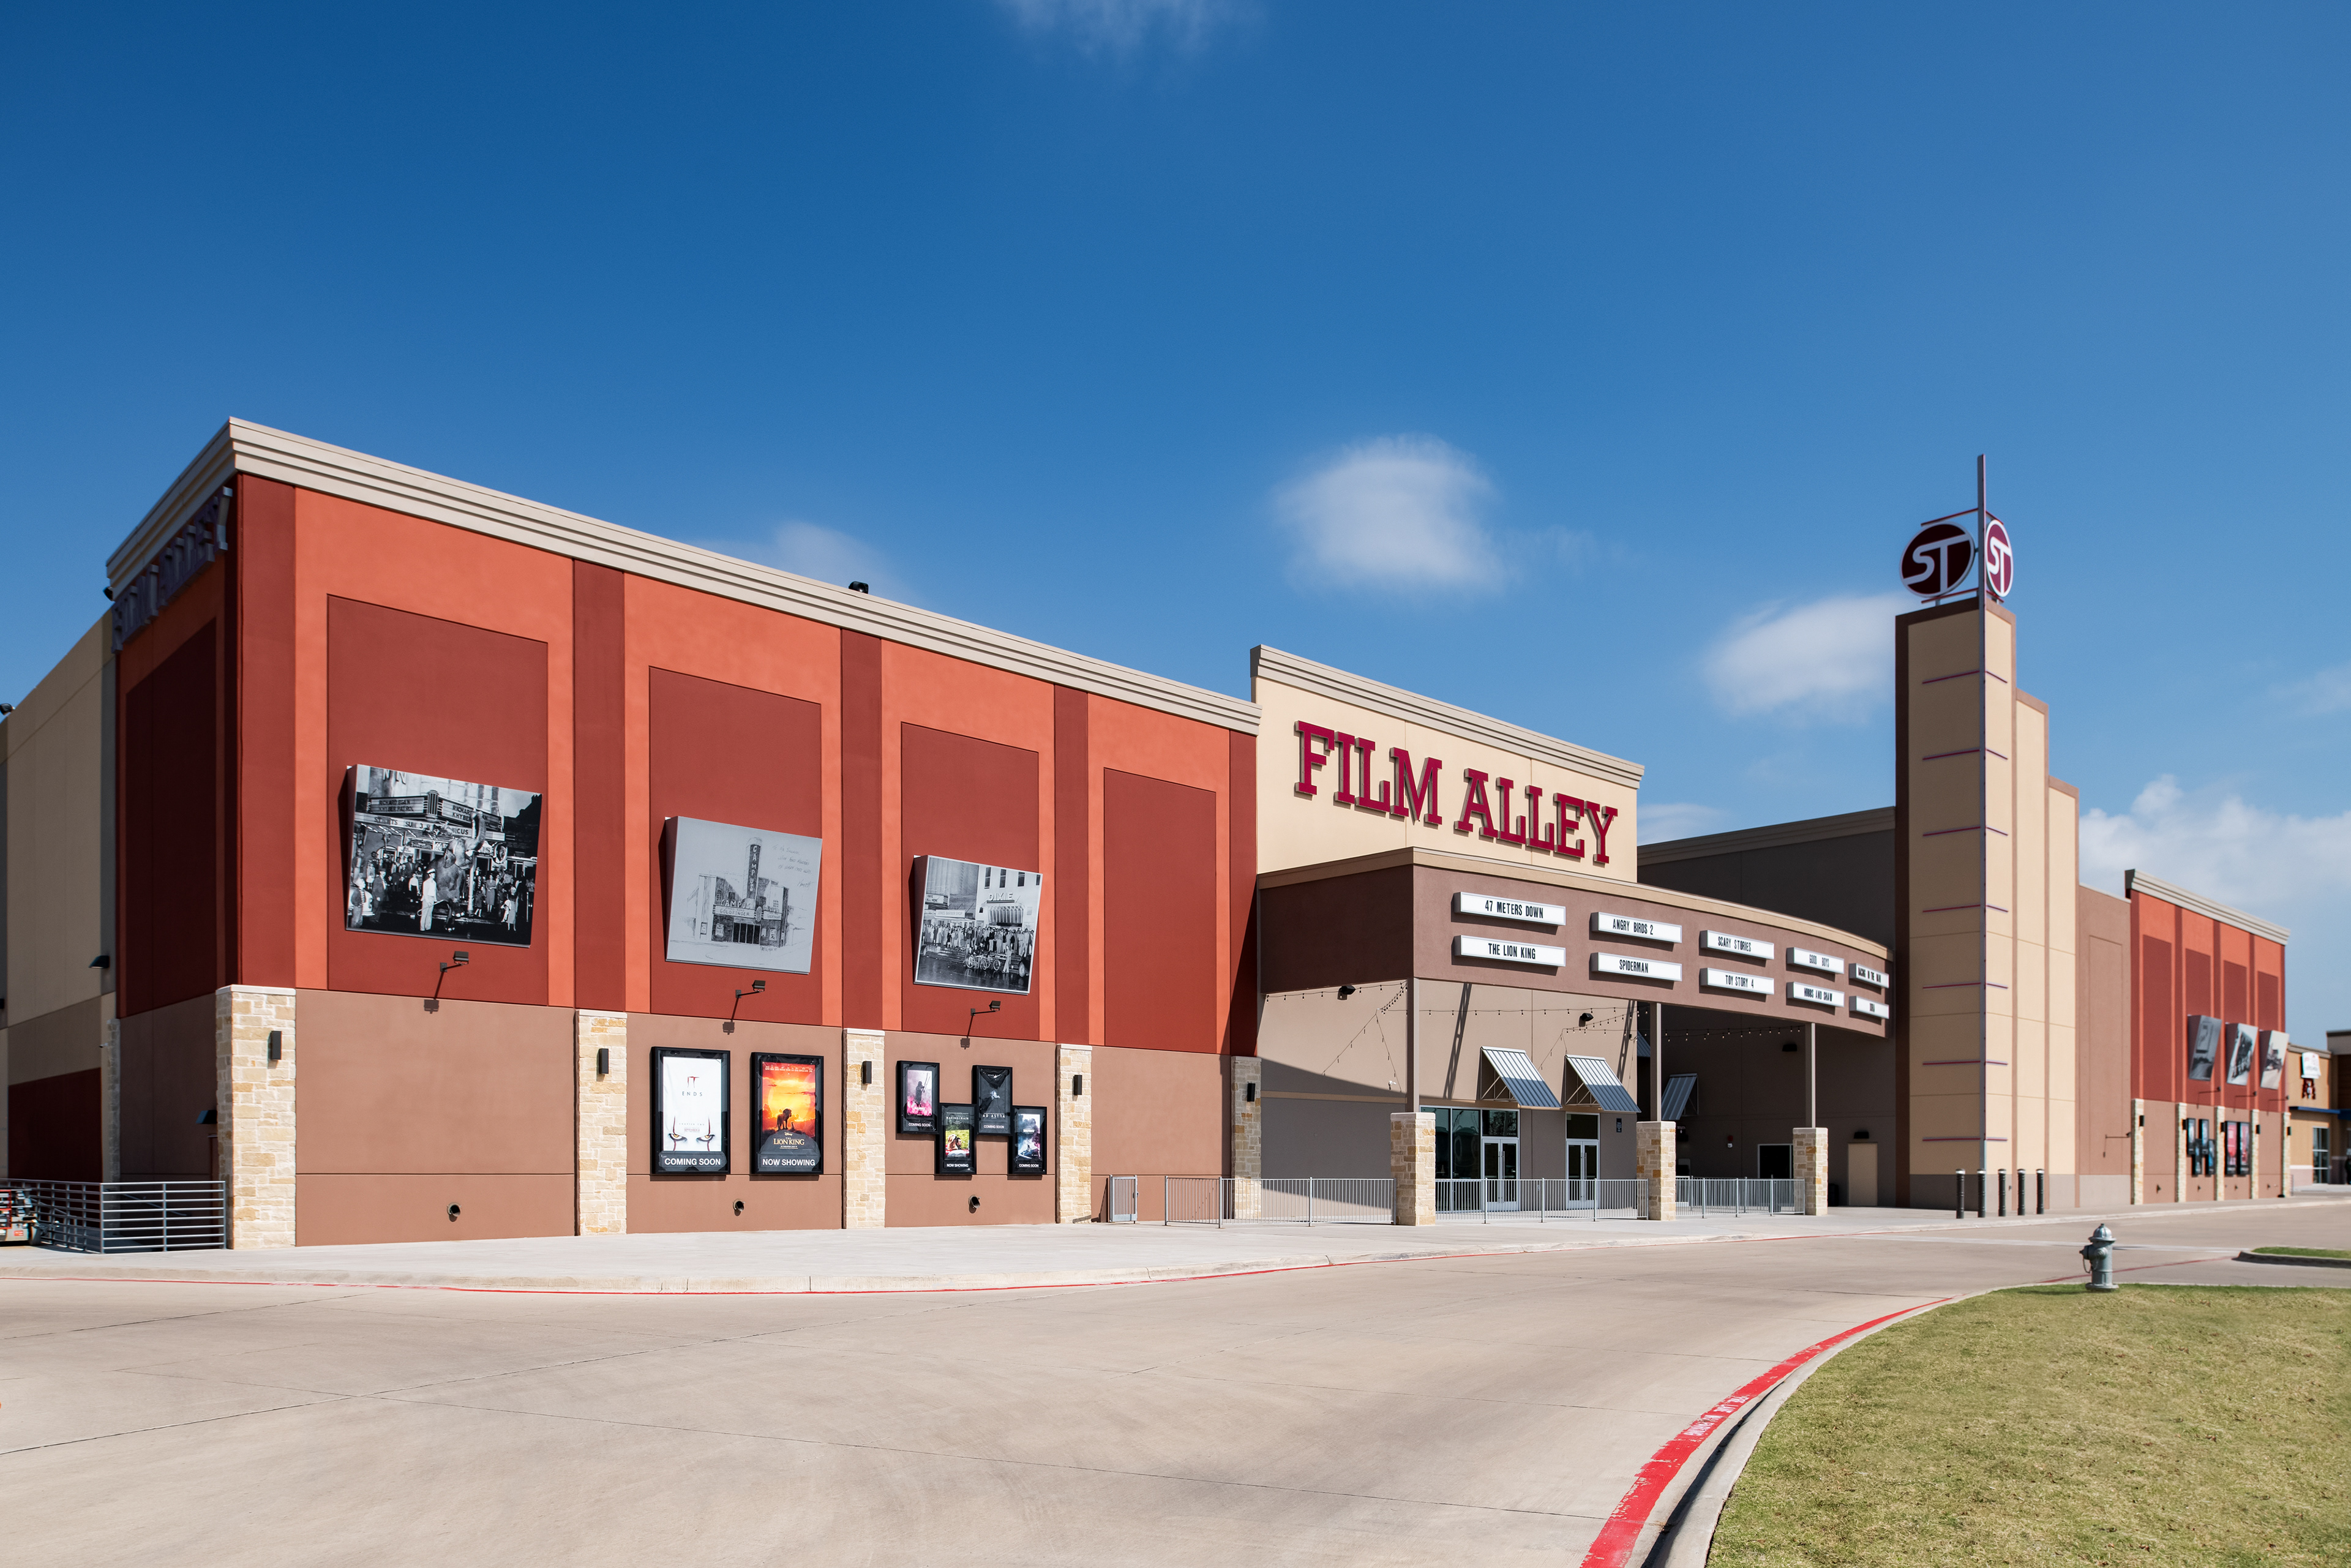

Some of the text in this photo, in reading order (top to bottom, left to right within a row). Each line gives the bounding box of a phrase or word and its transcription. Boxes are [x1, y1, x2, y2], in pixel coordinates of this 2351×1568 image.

[1294, 720, 1618, 864] FILM ALLEY
[452, 805, 471, 815] RICHAR
[988, 892, 1014, 901] DIXIE
[721, 899, 751, 909] CAMPUS
[1485, 900, 1543, 918] 47 METERS DOWN
[1613, 918, 1654, 935] ANGRY BIRDS 2
[1488, 943, 1536, 959] THE LION KING
[1718, 936, 1752, 952] SCARY STORIES
[1619, 959, 1649, 973] SPIDERMAN
[1735, 976, 1749, 988] STORY
[1751, 978, 1754, 989] 4
[687, 1076, 700, 1089] IT
